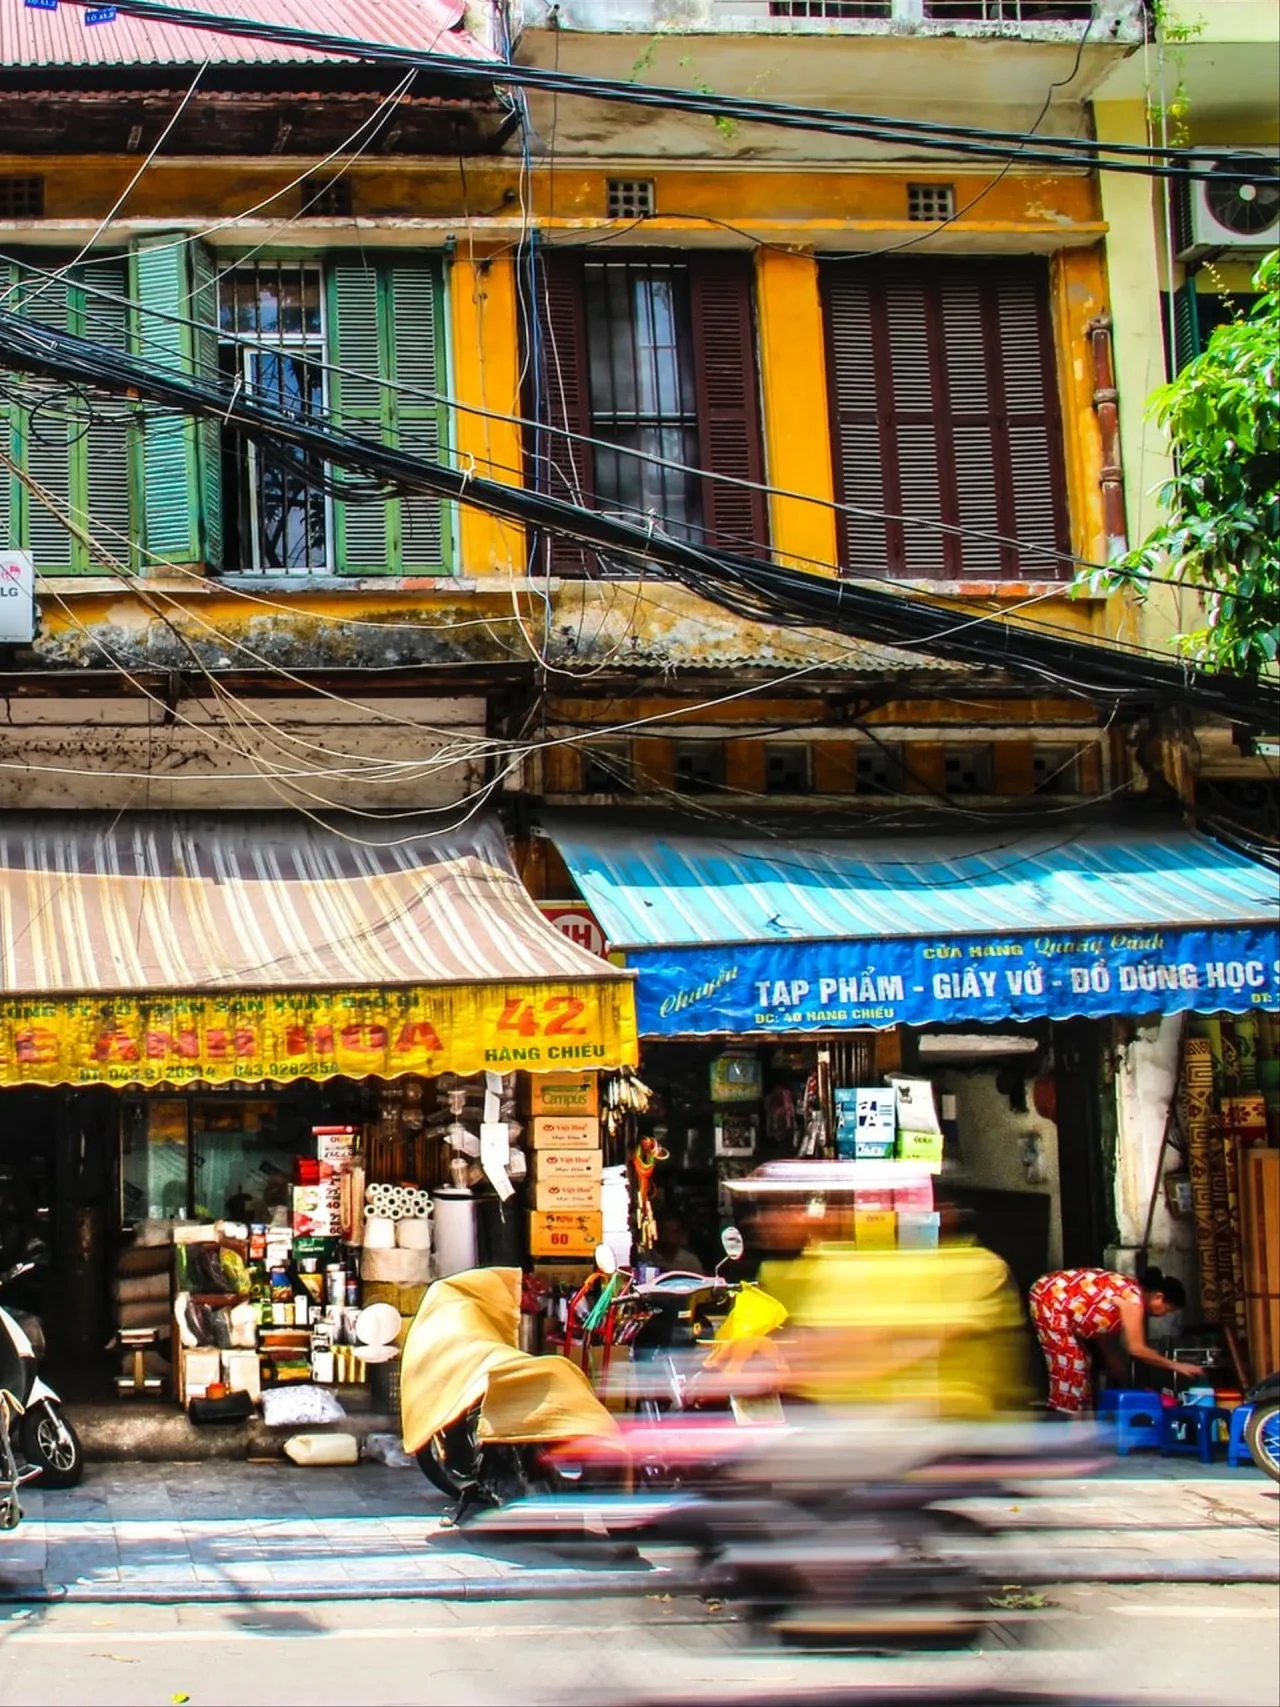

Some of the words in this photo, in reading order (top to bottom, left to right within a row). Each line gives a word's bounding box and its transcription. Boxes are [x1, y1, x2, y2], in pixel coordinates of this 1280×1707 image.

[0, 587, 18, 597] LG
[755, 979, 810, 1012] TẠP
[820, 966, 904, 1004] PHẨM
[933, 963, 997, 999] GIẤY
[1005, 961, 1044, 996] VỞ
[1070, 959, 1110, 993] ĐỒ
[1120, 960, 1198, 992] DÙNG
[1206, 961, 1264, 993] HỌC
[497, 996, 586, 1036] 42
[285, 1021, 444, 1056] HOA
[485, 1046, 540, 1062] HÀNG
[548, 1042, 605, 1059] CHIẾU
[551, 1233, 568, 1245] 60
